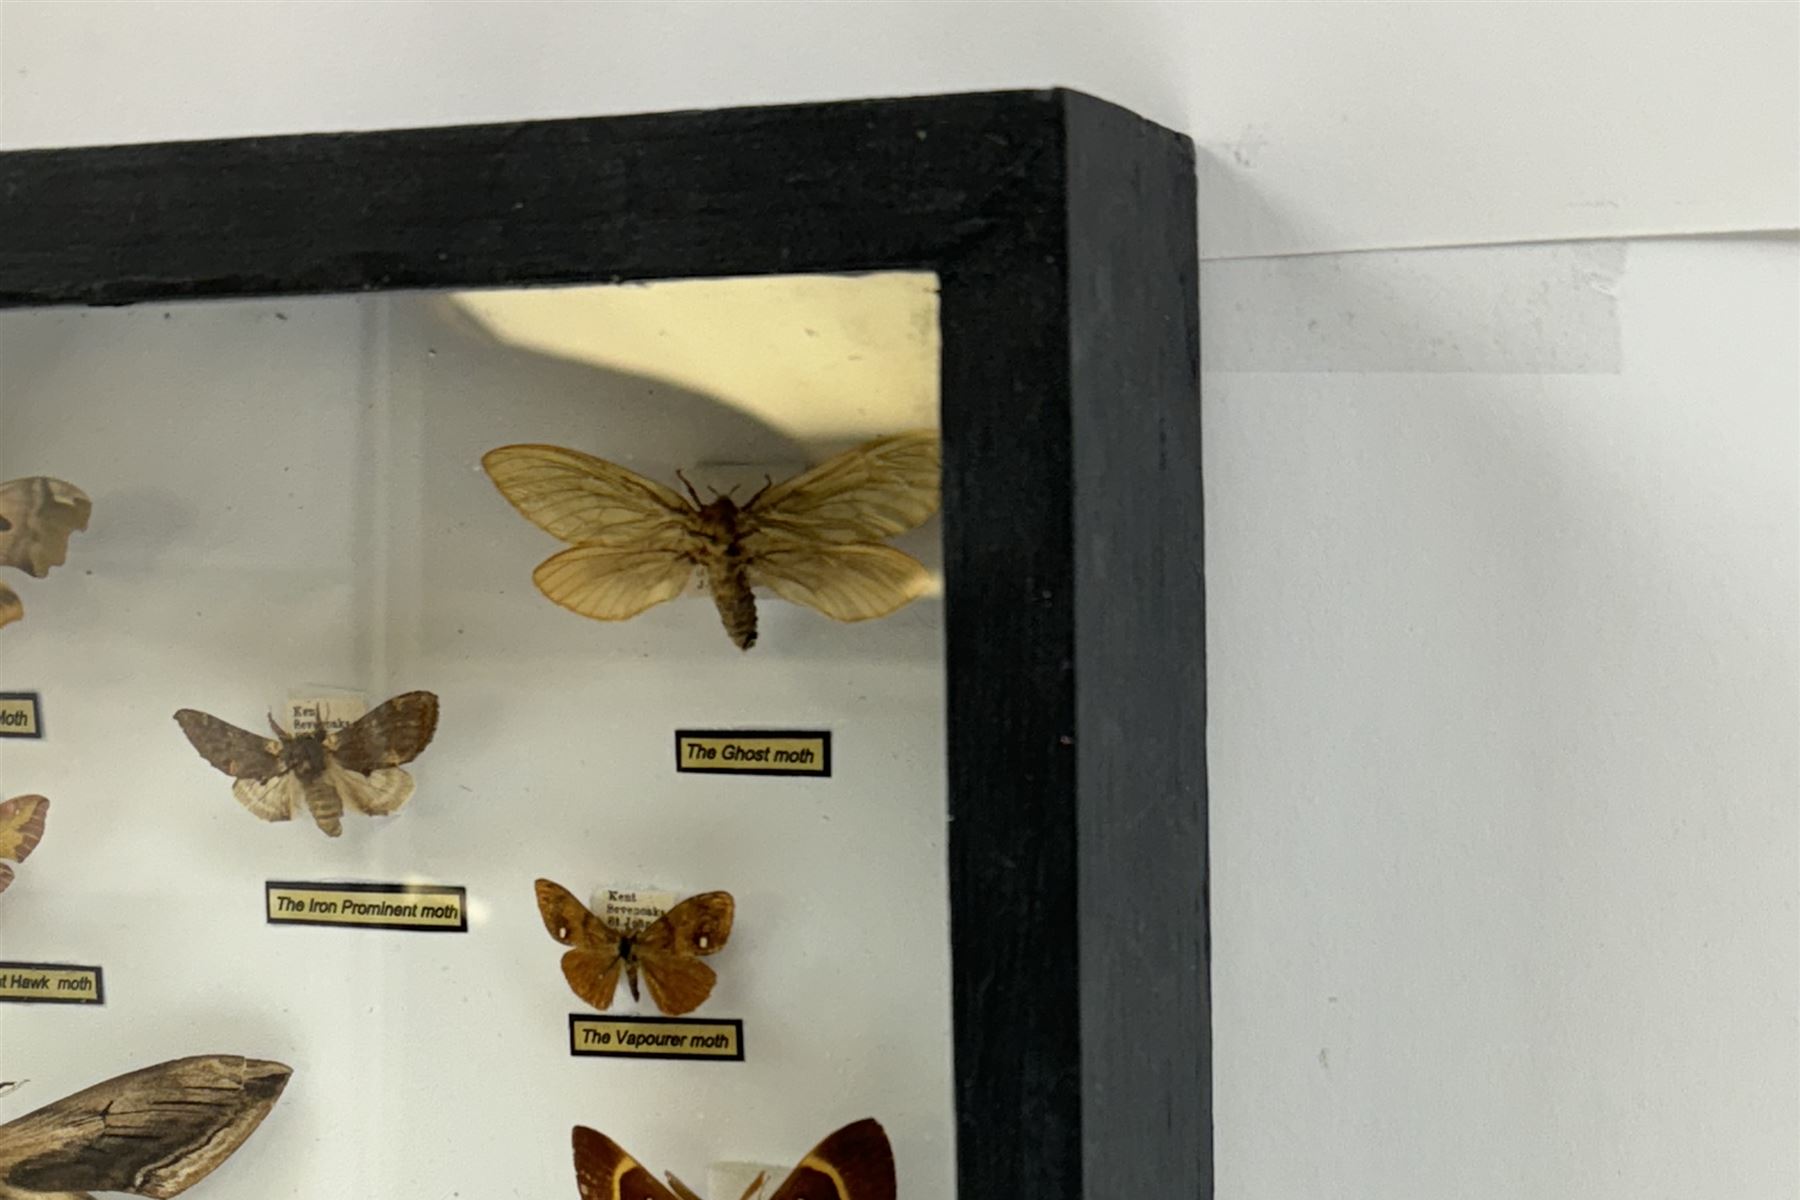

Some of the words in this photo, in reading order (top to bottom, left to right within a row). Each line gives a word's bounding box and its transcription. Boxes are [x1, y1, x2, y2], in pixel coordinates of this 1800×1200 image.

[686, 743, 717, 760] The
[721, 744, 770, 762] Ghost
[773, 748, 814, 763] moth
[608, 890, 637, 902] Kent
[276, 896, 305, 912] The
[308, 898, 337, 914] Iron
[341, 899, 418, 918] Prominent
[420, 904, 458, 919] moth
[10, 974, 50, 990] Hawk
[57, 976, 92, 991] moth
[582, 1028, 611, 1044] The
[616, 1029, 689, 1048] Vapourer
[690, 1034, 729, 1048] moth
